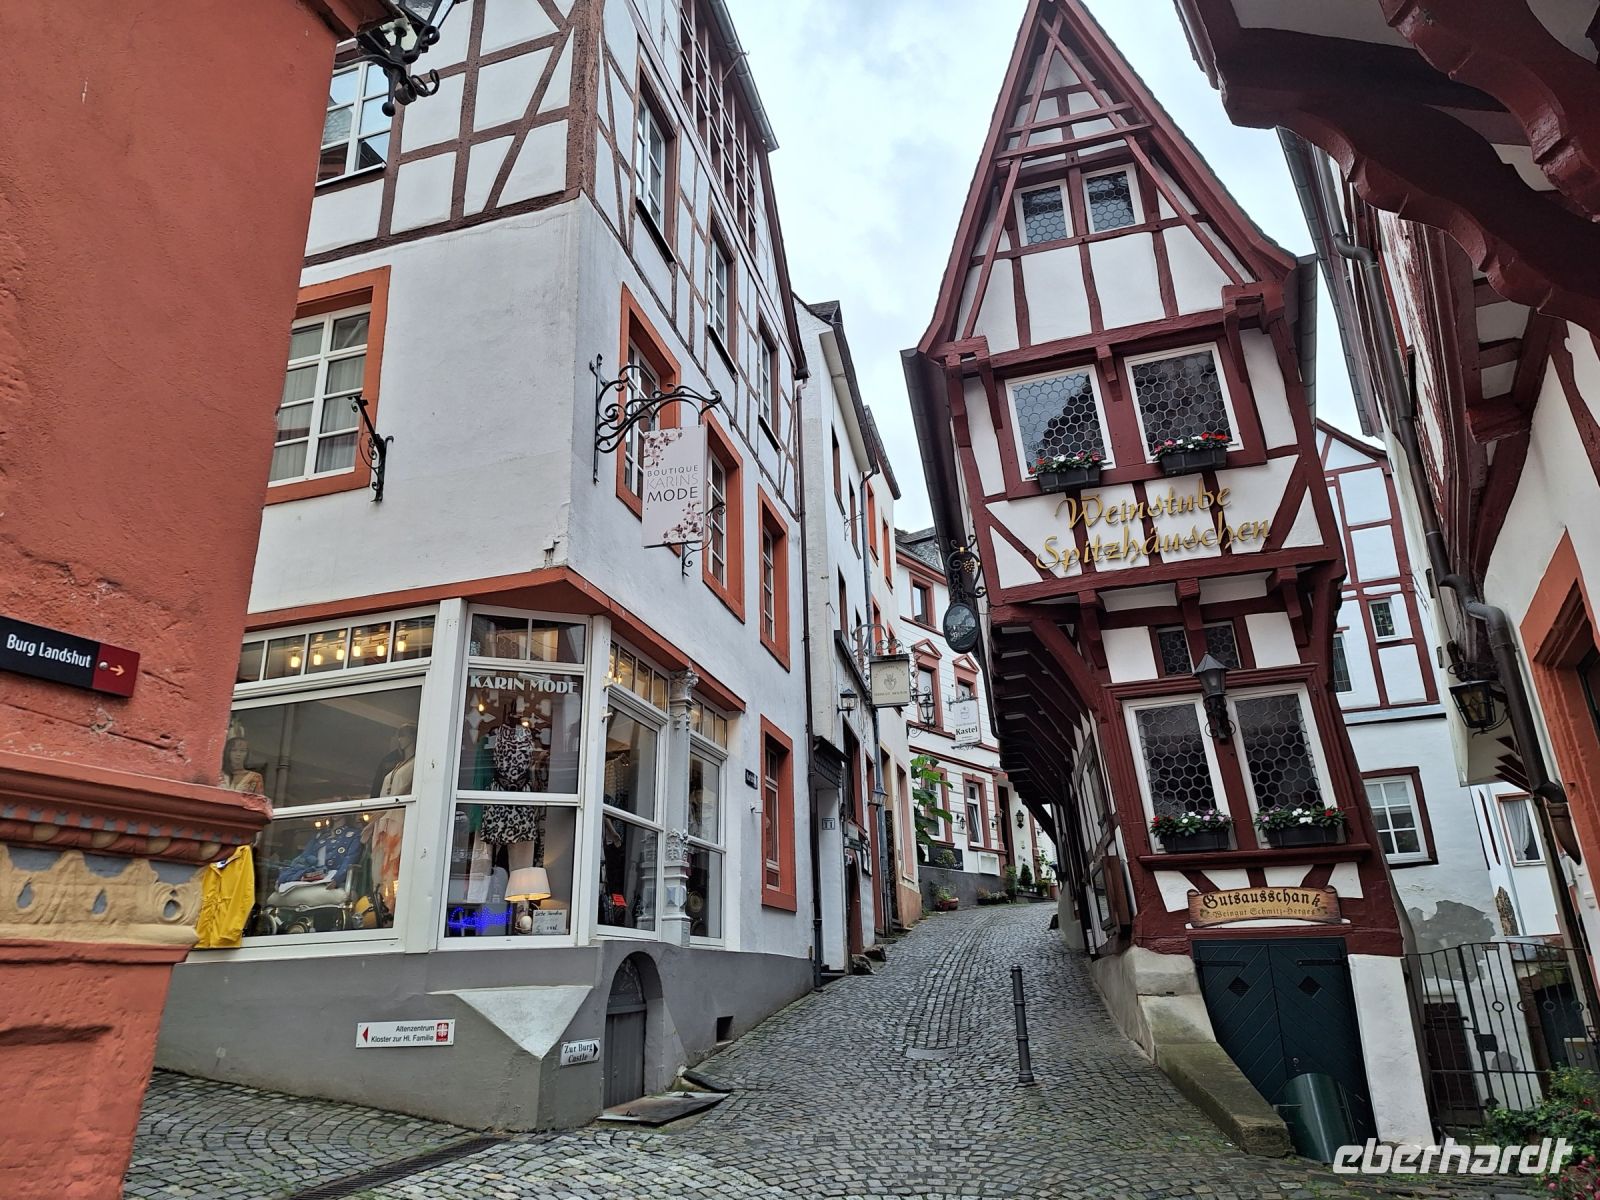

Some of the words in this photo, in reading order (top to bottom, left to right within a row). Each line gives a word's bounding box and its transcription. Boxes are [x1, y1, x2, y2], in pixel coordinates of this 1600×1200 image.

[647, 465, 699, 477] BOUTIQUE
[647, 473, 699, 490] KARINS
[647, 486, 698, 504] MODE
[1055, 479, 1233, 530] Weinstube
[1035, 511, 1271, 573] Spitzhäuschen
[6, 633, 36, 657] Burg
[38, 642, 92, 668] Landshut
[469, 674, 525, 691] KARIN
[529, 679, 579, 694] MODE
[955, 725, 978, 736] Kastel
[1203, 888, 1321, 909] Gutsausschank
[1213, 908, 1247, 918] Weingut
[370, 1035, 391, 1043] Kloster
[412, 1033, 434, 1042] Familie
[564, 1045, 576, 1054] Zur
[578, 1043, 593, 1053] Burg
[568, 1053, 588, 1063] Castle
